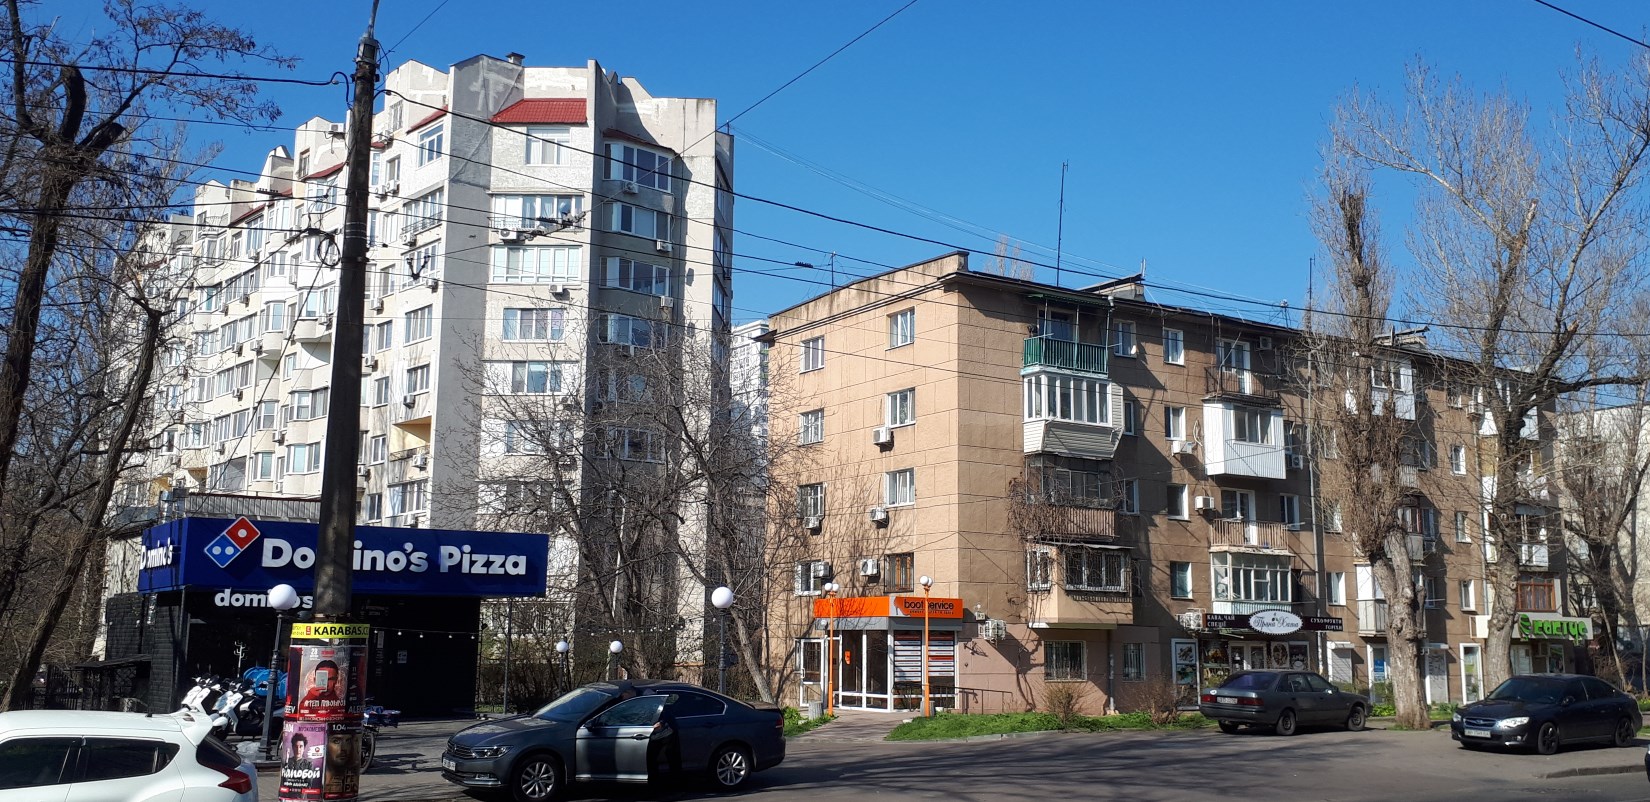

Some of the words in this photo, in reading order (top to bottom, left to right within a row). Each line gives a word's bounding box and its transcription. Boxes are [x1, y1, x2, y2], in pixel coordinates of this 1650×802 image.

[261, 538, 429, 573] Doino's
[439, 544, 527, 576] Pizza
[214, 588, 314, 609] domios
